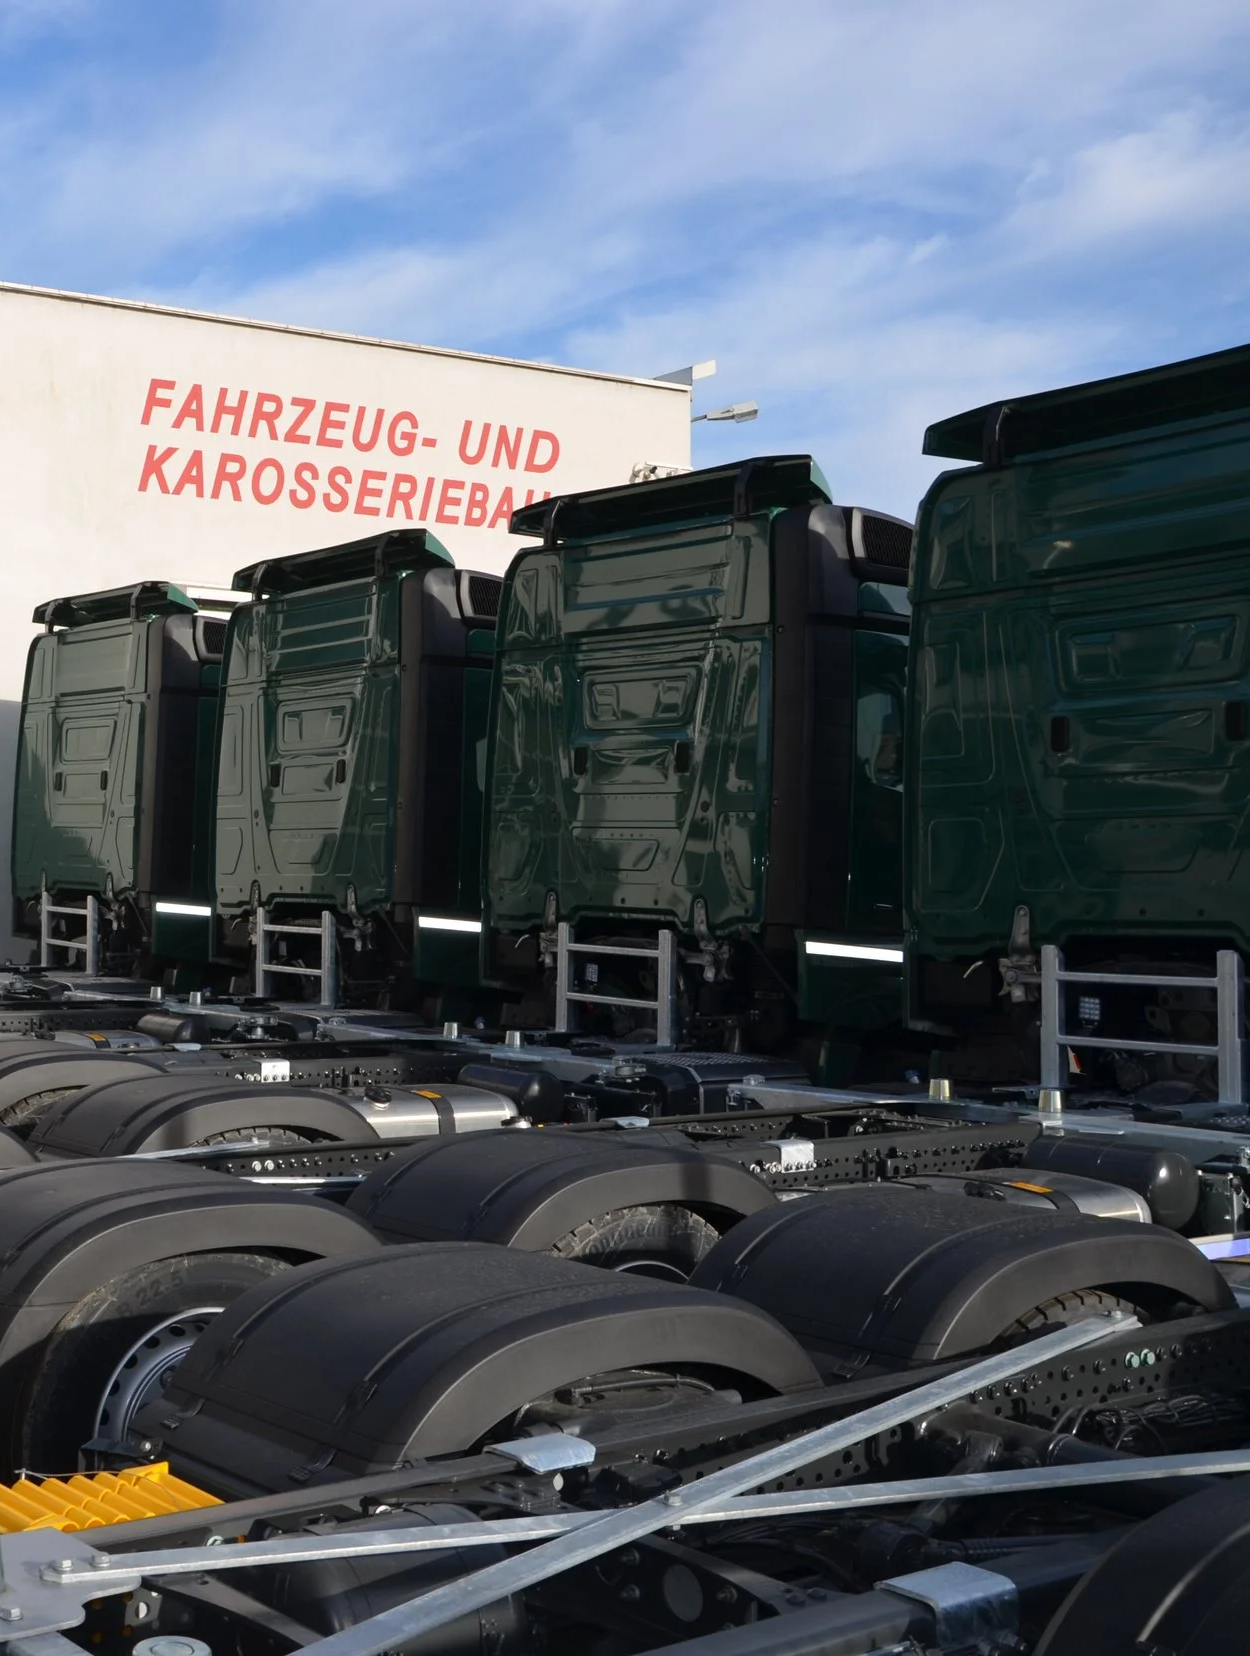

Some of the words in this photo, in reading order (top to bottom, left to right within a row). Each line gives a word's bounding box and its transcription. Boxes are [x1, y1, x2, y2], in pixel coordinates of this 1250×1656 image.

[141, 378, 438, 457] FAHRZEUG-
[458, 419, 561, 474] UND
[138, 445, 552, 529] KAROSSERIEBA
